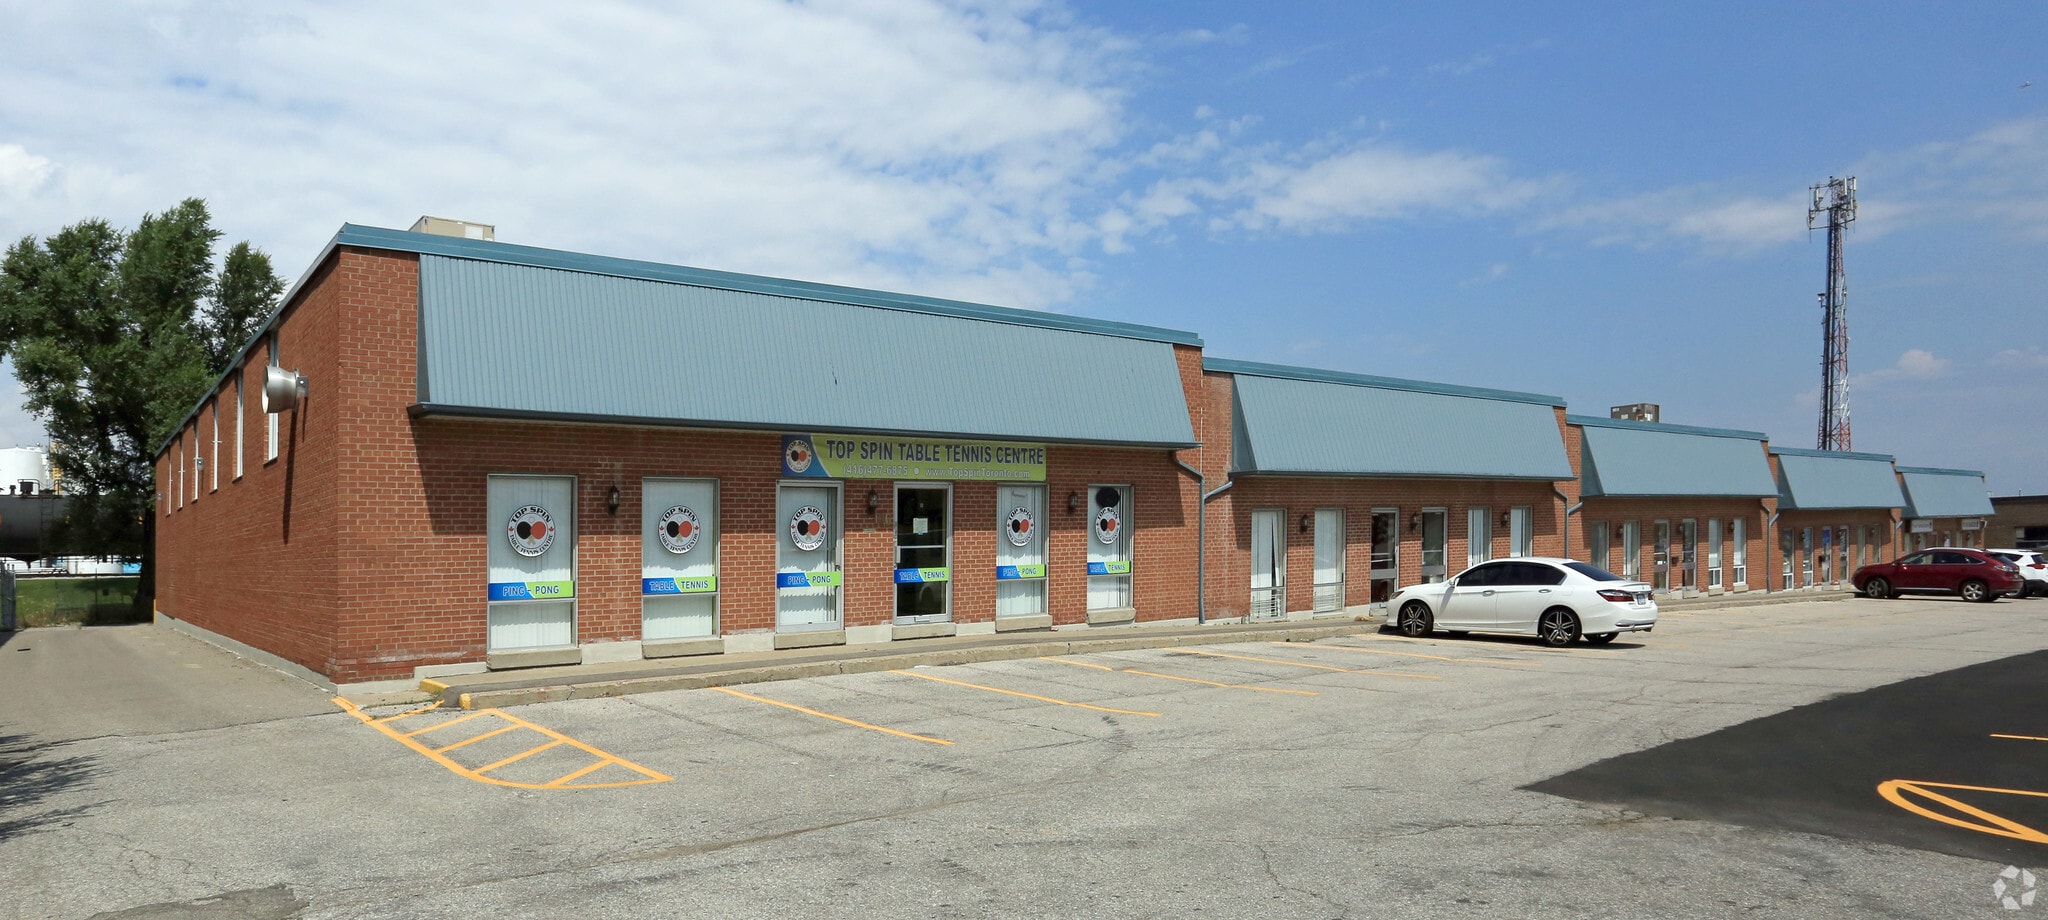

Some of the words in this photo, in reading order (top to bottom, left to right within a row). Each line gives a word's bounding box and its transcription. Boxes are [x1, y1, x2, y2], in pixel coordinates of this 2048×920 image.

[827, 440, 855, 459] TOP
[861, 441, 893, 460] SPIN
[898, 443, 940, 462] TABLE
[945, 444, 992, 463] TENNIS
[996, 447, 1044, 465] CENTRE
[511, 507, 528, 523] TOP
[530, 506, 552, 523] SPIN
[662, 508, 676, 522] TOP
[678, 507, 697, 522] SPIN
[793, 508, 806, 521] TOP
[807, 507, 824, 521] SPIN
[510, 534, 520, 549] TABLE
[540, 534, 553, 553] CENTRE
[924, 571, 945, 579] TENNIS
[1022, 567, 1037, 575] PONG
[649, 581, 675, 591] TABLE
[681, 580, 709, 590] TENNIS
[788, 575, 805, 585] PING
[812, 575, 831, 584] PONG
[503, 585, 526, 597] PING
[535, 584, 560, 595] PONG
